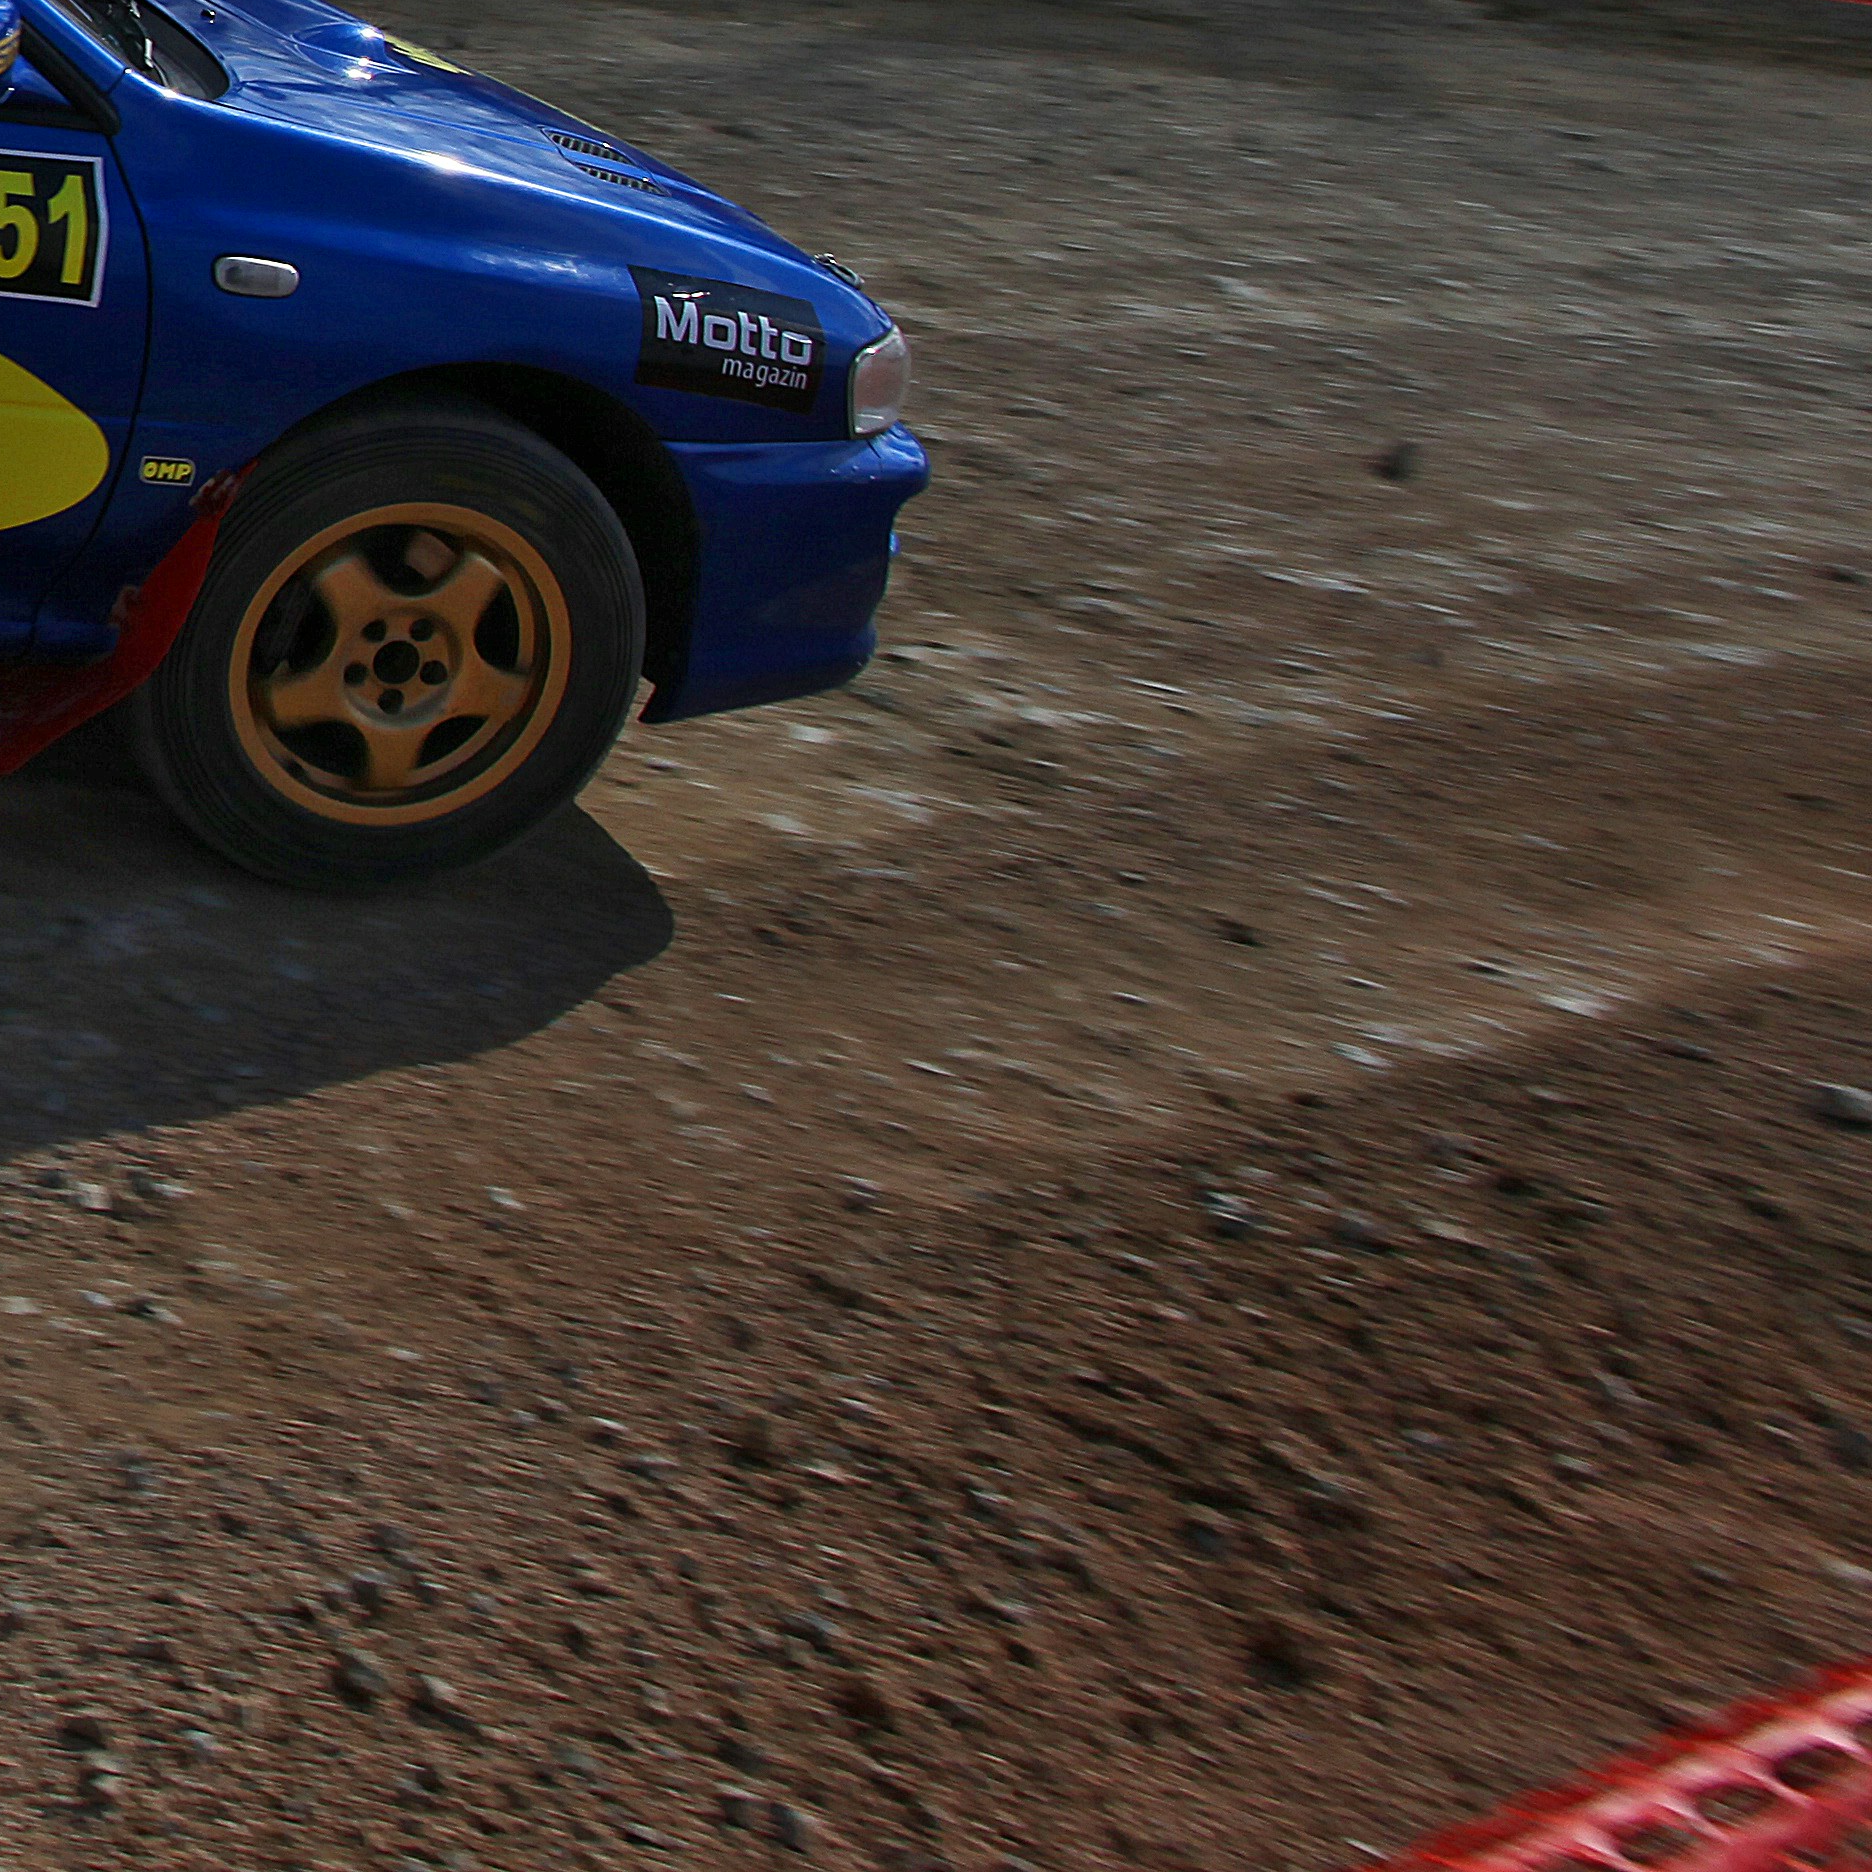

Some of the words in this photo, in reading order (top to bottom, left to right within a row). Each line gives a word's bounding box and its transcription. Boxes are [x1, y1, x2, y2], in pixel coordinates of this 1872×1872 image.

[654, 295, 813, 366] Motto
[722, 357, 808, 390] magazin
[143, 461, 192, 480] OMP
